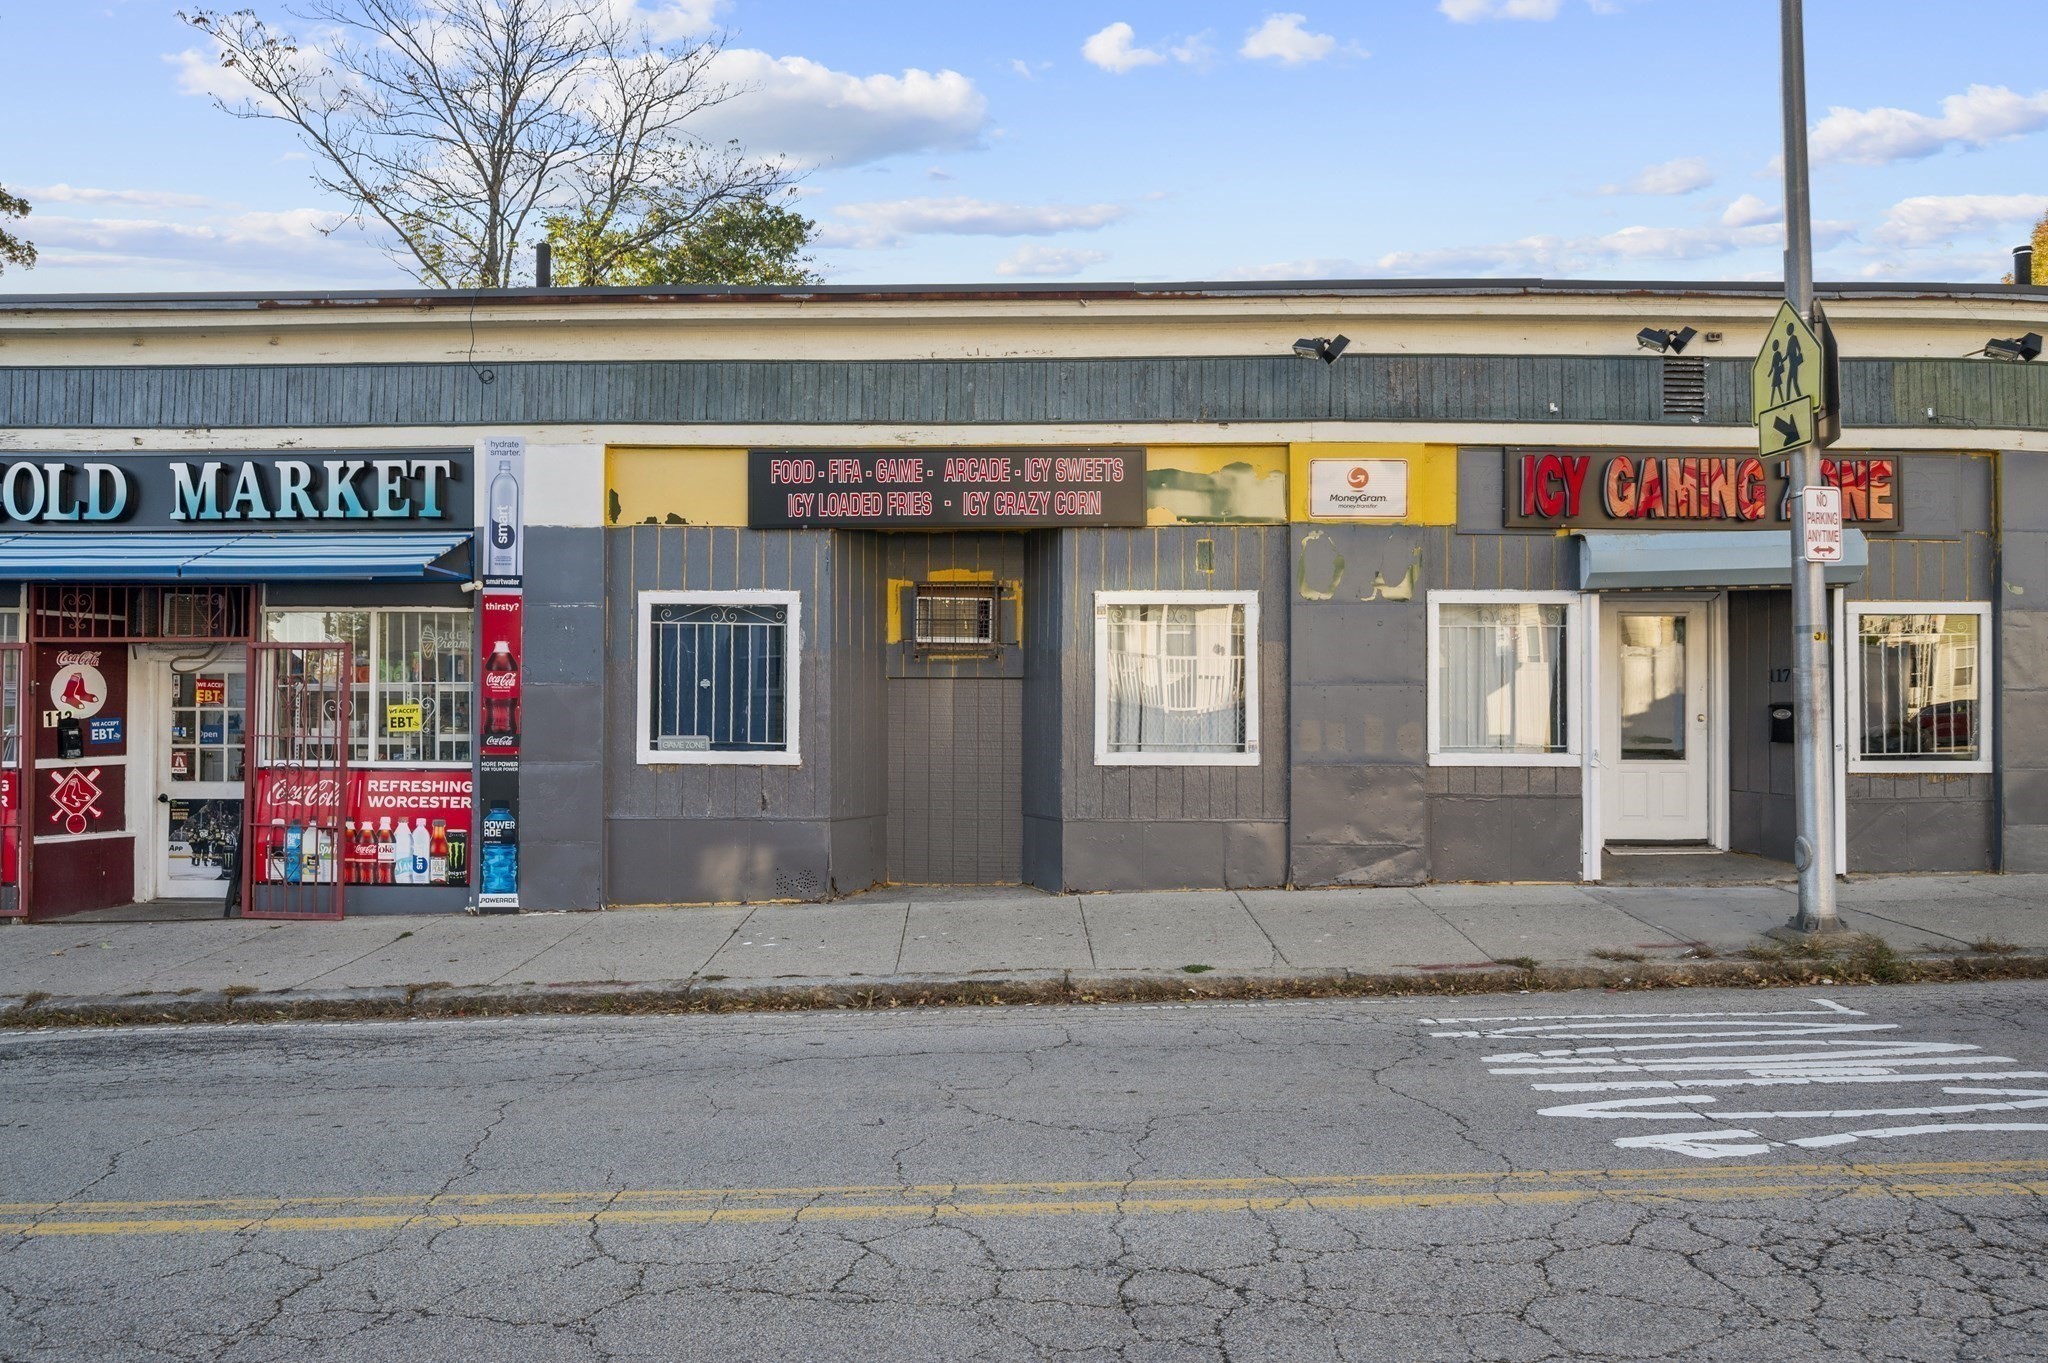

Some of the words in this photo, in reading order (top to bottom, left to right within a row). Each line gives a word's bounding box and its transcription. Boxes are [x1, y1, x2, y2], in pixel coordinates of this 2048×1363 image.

[490, 440, 519, 449] hydrate
[490, 449, 521, 457] smarter.
[771, 459, 815, 484] FOOD
[828, 459, 862, 483] FIFA
[875, 458, 923, 483] GAME
[944, 457, 1011, 483] ARCADE
[1024, 457, 1052, 482] ICY
[1055, 457, 1124, 482] SWEETS
[169, 459, 450, 520] MARKET
[1521, 454, 1590, 518] ICY
[1603, 455, 1766, 520] GAMING
[787, 492, 814, 517] ICY
[818, 492, 883, 517] LOADED
[886, 491, 932, 516] FRIES
[962, 491, 990, 516] ICY
[993, 491, 1050, 516] CRAZY
[1054, 490, 1102, 516] CORN
[1329, 493, 1387, 504] MoneyGram
[1816, 494, 1827, 507] NO
[497, 504, 508, 544] smart
[1806, 511, 1838, 525] PARKING
[1807, 529, 1839, 543] ANYTIME
[485, 602, 520, 612] thirsty?
[436, 635, 468, 649] Cream
[443, 631, 464, 640] ICE
[1770, 668, 1791, 682] 117
[196, 689, 221, 702] EBT
[390, 716, 413, 728] EBT
[91, 728, 115, 741] EBT
[662, 741, 685, 749] GAME
[685, 741, 706, 749] ZONE
[367, 779, 473, 793] REFRESHING
[368, 795, 472, 809] WORCESTER
[484, 820, 516, 830] POWER
